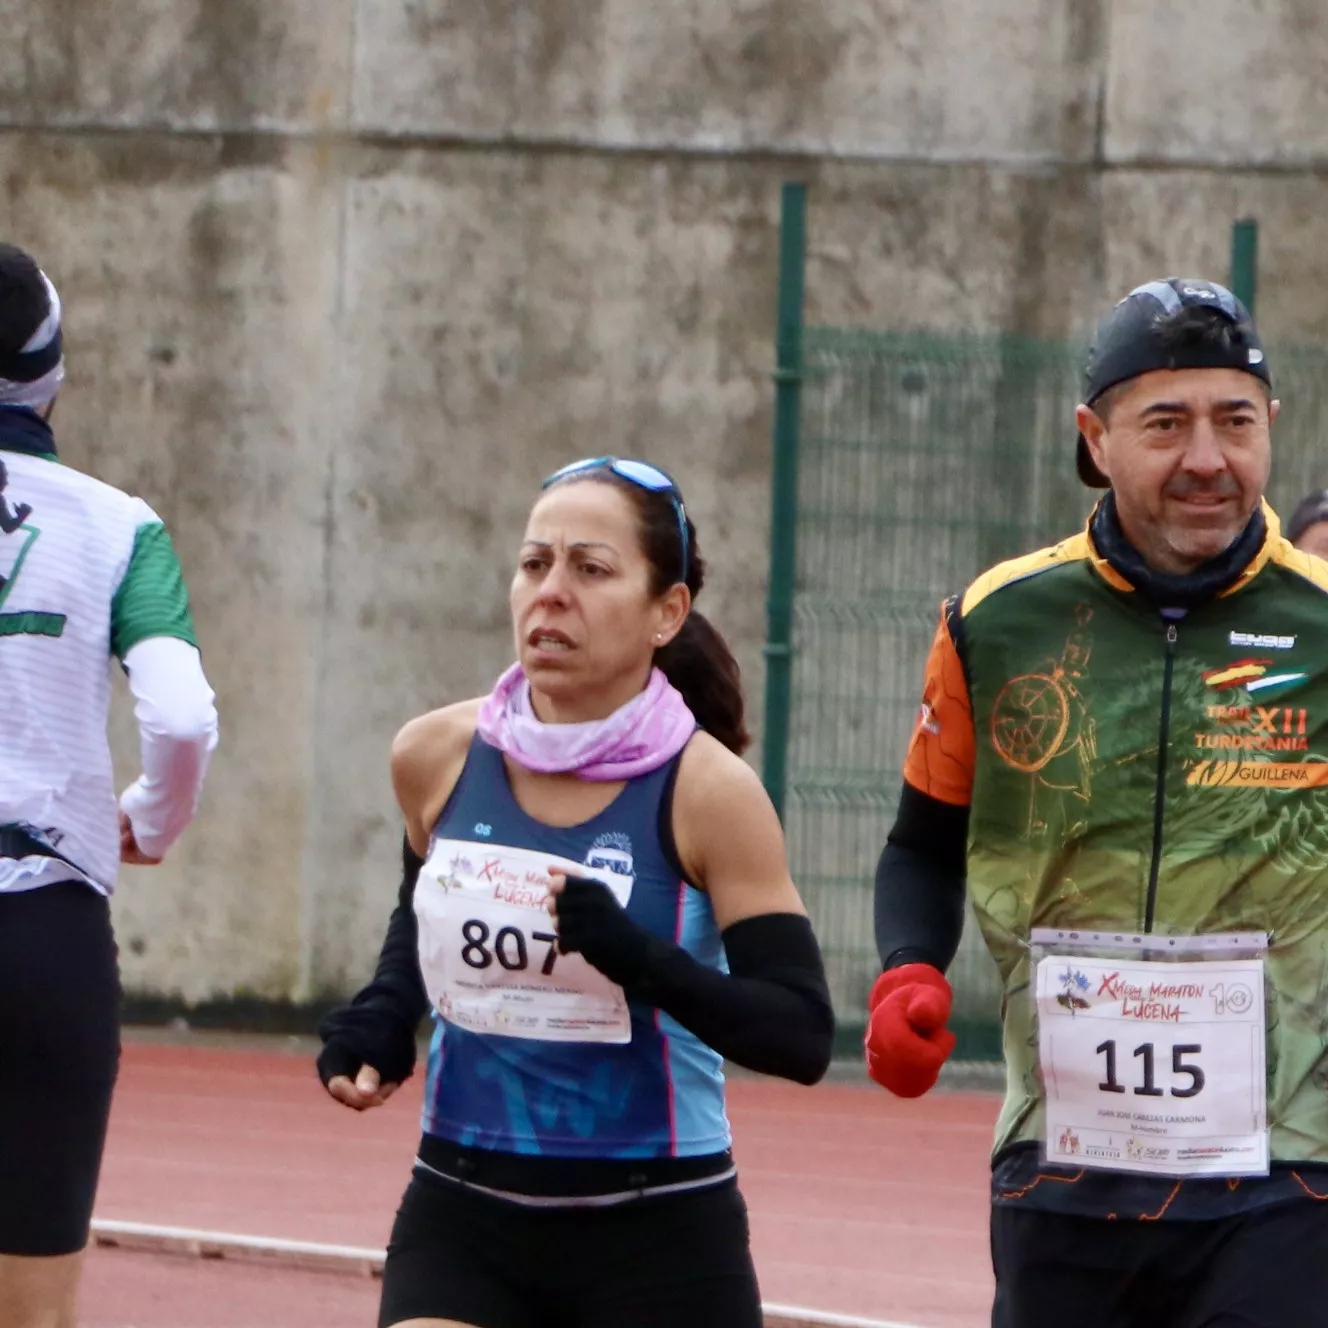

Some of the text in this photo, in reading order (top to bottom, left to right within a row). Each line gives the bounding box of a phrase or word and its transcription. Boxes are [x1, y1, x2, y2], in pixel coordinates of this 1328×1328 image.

[1195, 733, 1309, 750] TURDETANIA
[1239, 767, 1309, 781] GUILLENA
[461, 918, 558, 976] 807
[1121, 997, 1190, 1022] LUCENA
[1096, 1039, 1205, 1098] 115
[1164, 1114, 1207, 1124] CARMONA
